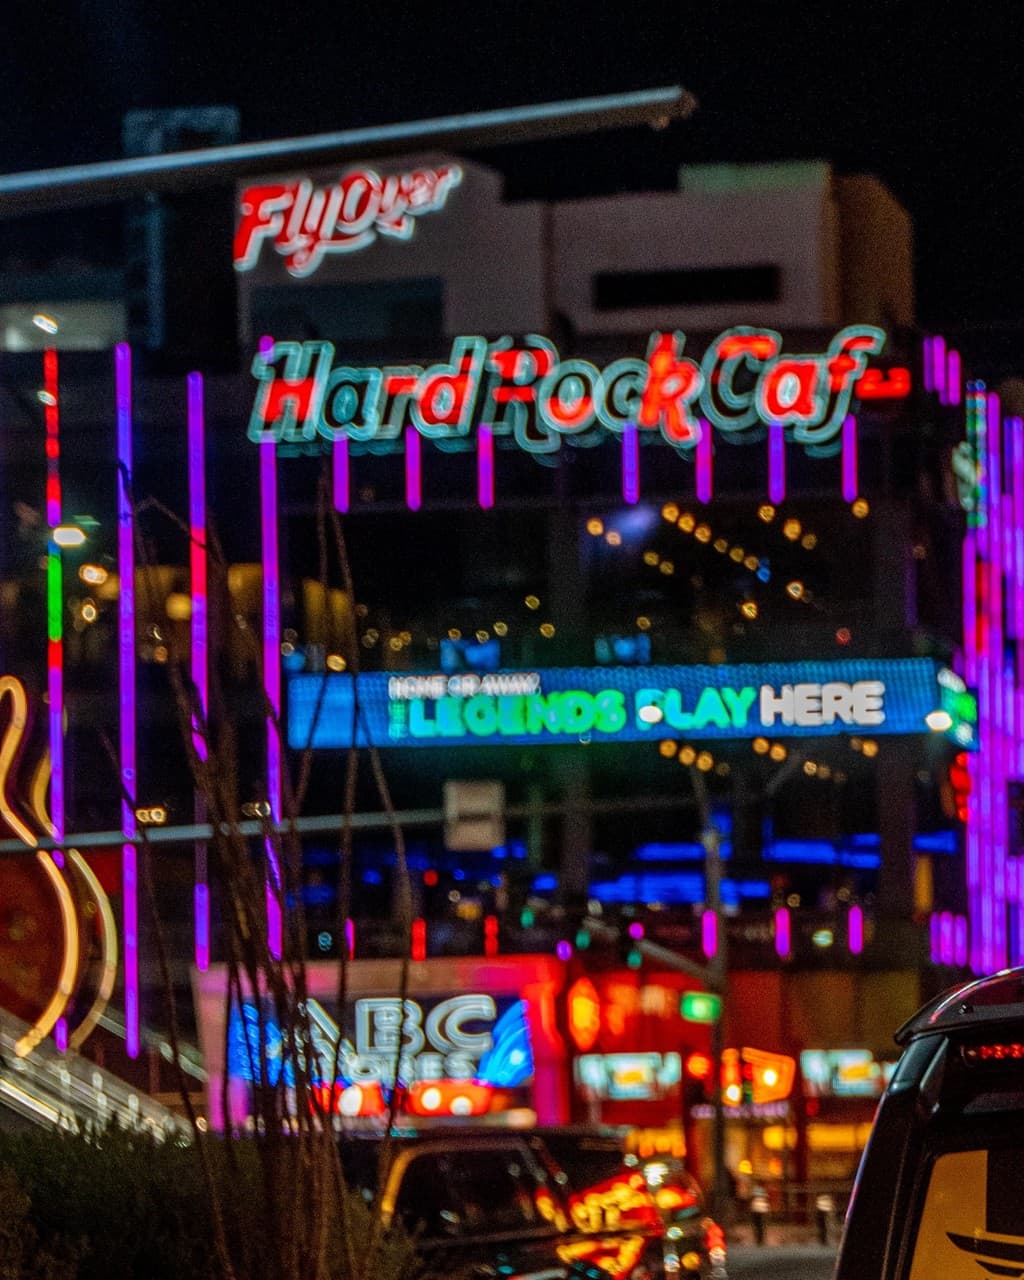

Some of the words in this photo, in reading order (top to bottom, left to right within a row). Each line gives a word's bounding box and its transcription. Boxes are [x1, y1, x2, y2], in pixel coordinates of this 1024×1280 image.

[246, 334, 488, 447] Hard
[484, 332, 703, 453] Rock
[408, 688, 627, 738] LEGENDS
[634, 686, 757, 732] PLAY
[759, 680, 885, 728] HERE
